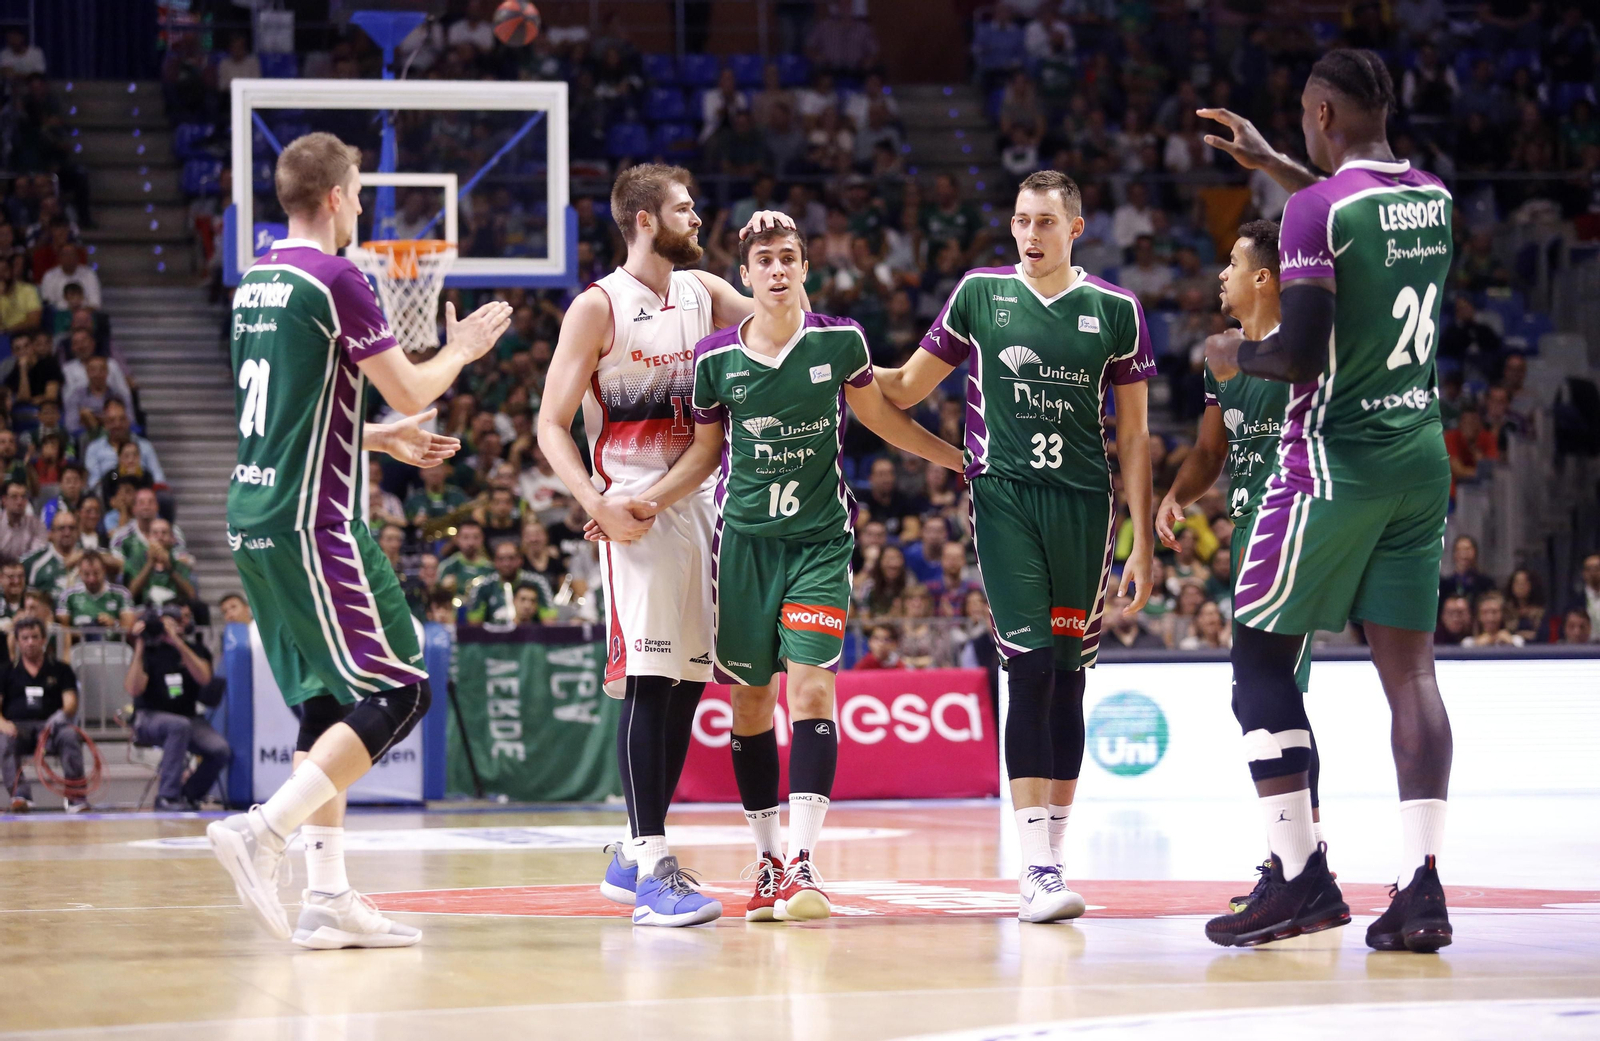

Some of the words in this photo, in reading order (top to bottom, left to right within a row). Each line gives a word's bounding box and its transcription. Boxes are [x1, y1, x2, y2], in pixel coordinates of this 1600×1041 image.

[1379, 199, 1446, 231] LESSORT
[1386, 282, 1437, 371] 26
[1039, 364, 1091, 384] Unicaja
[238, 358, 271, 438] 21
[780, 416, 831, 436] Unicaja
[1030, 432, 1064, 469] 33
[768, 480, 801, 518] 16
[786, 611, 842, 631] worten
[1006, 625, 1031, 639] SPALDING
[644, 638, 671, 647] Zaragoza
[688, 657, 713, 665] MERCURY
[727, 660, 752, 669] SPALDING
[1098, 735, 1157, 765] Uni
